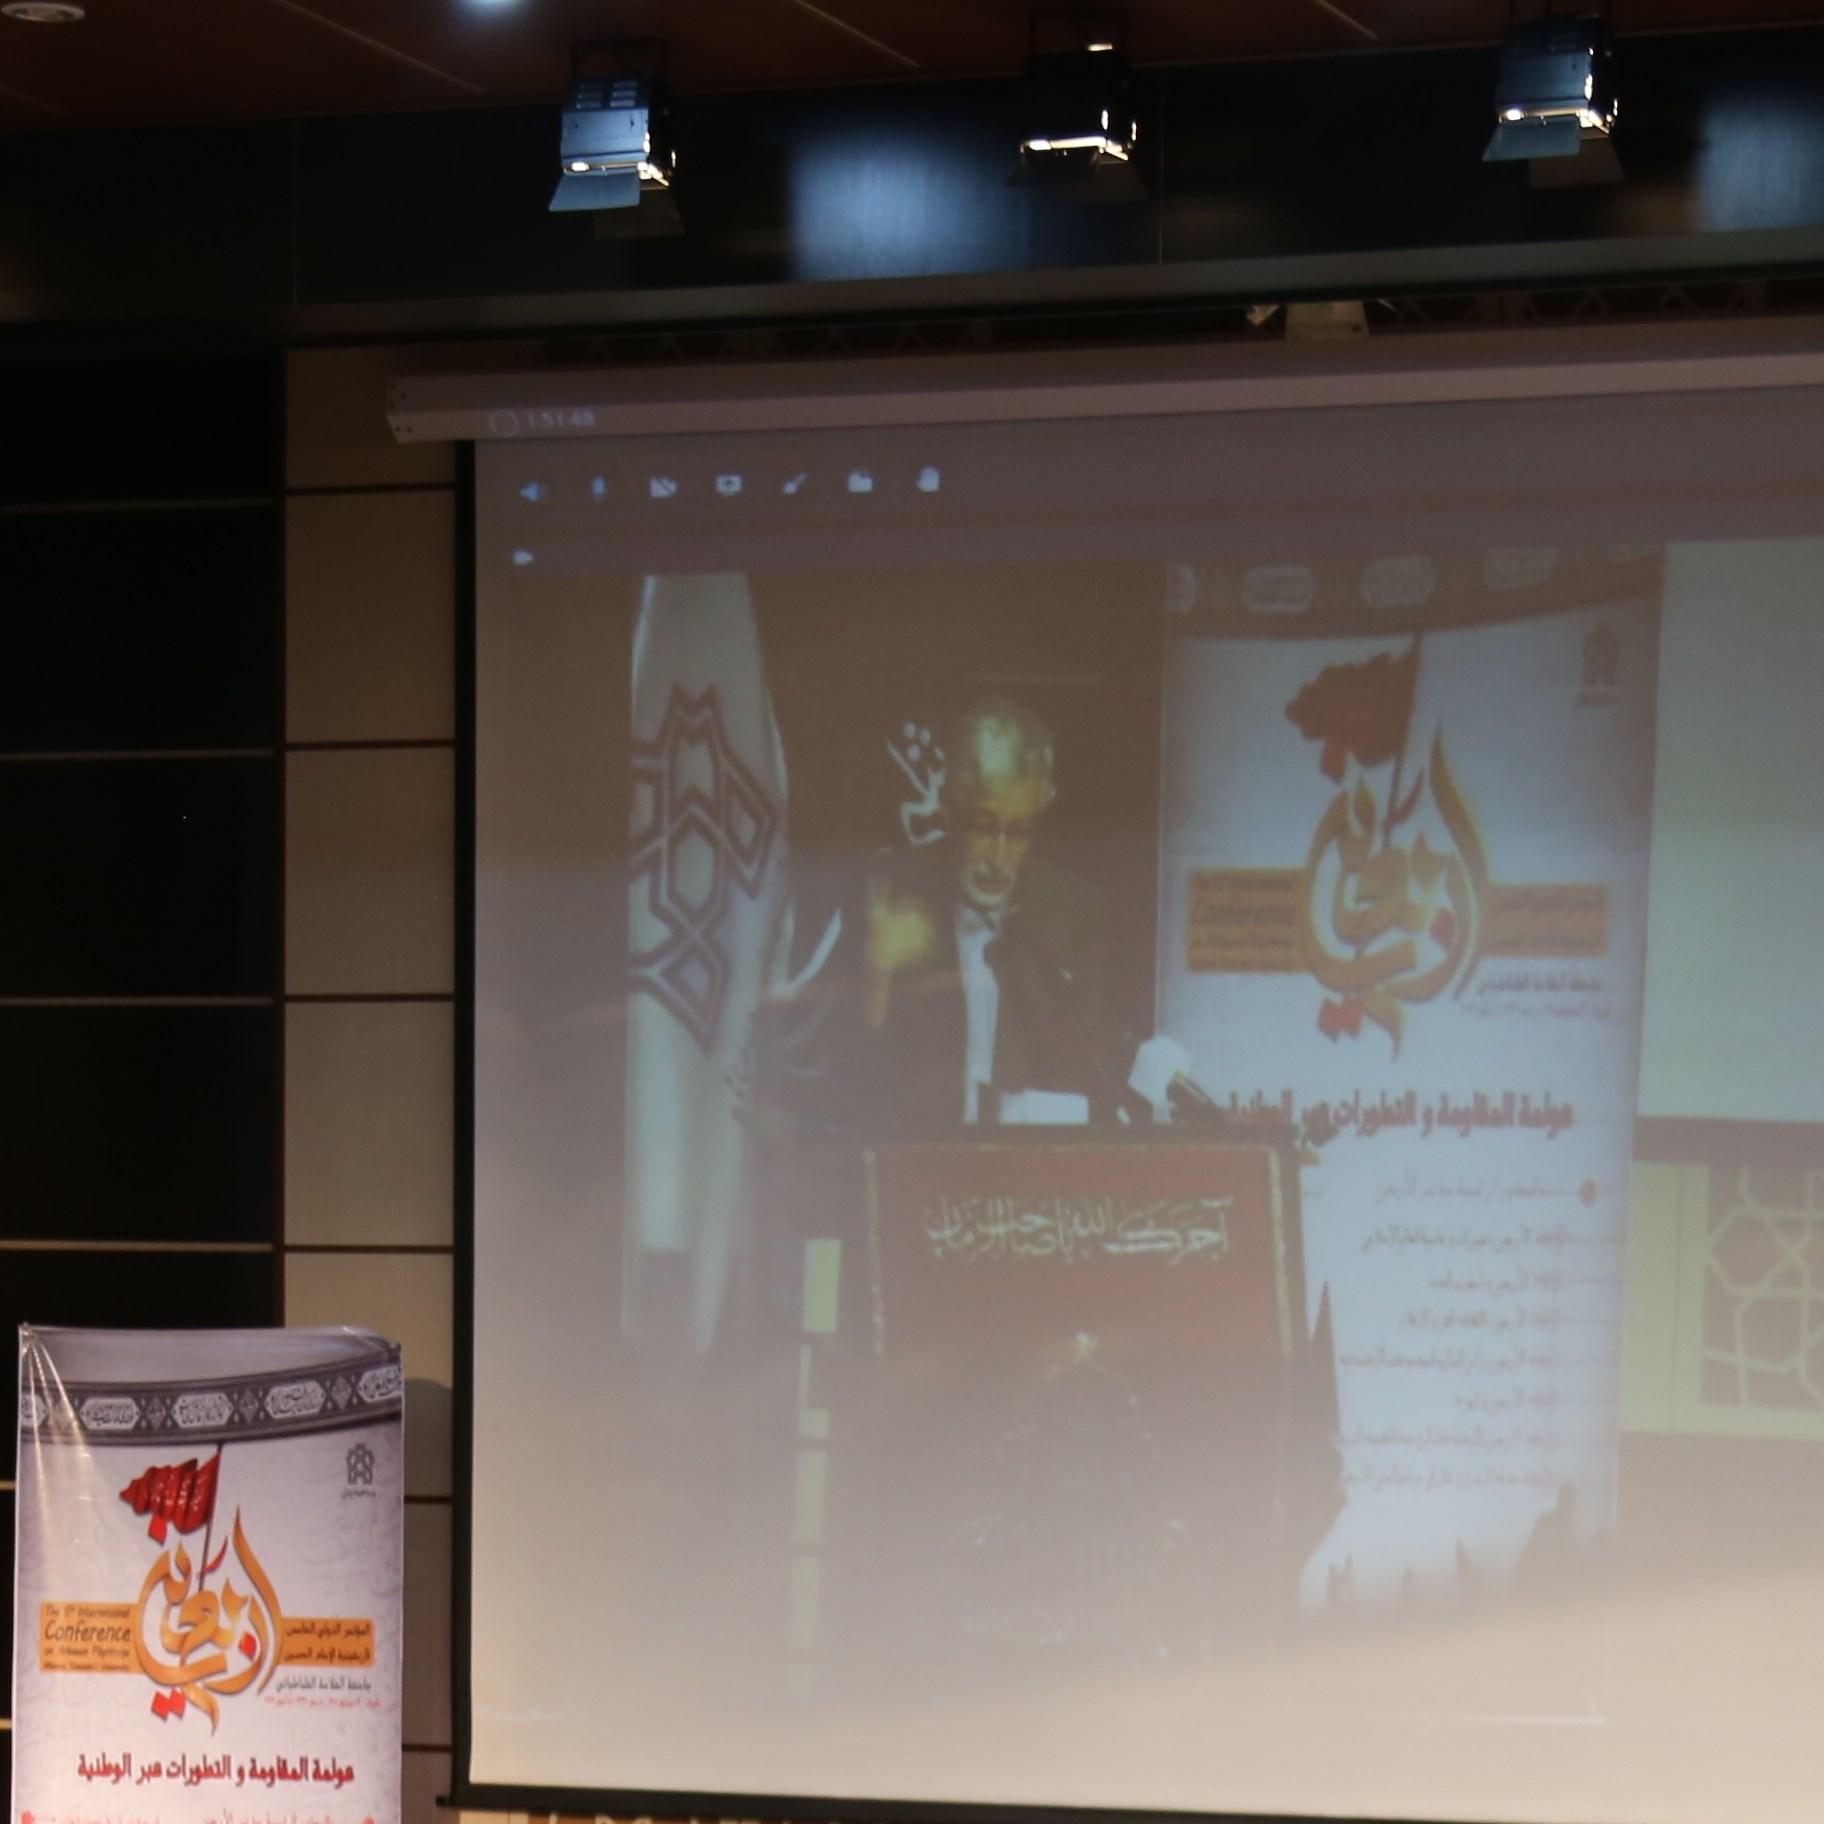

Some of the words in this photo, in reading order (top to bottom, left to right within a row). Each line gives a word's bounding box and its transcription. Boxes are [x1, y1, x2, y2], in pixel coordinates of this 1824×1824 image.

[44, 1618, 130, 1642] Conference
[166, 1753, 232, 1786] التطورات
[235, 1767, 246, 1787] و
[249, 1756, 309, 1788] المقاومة
